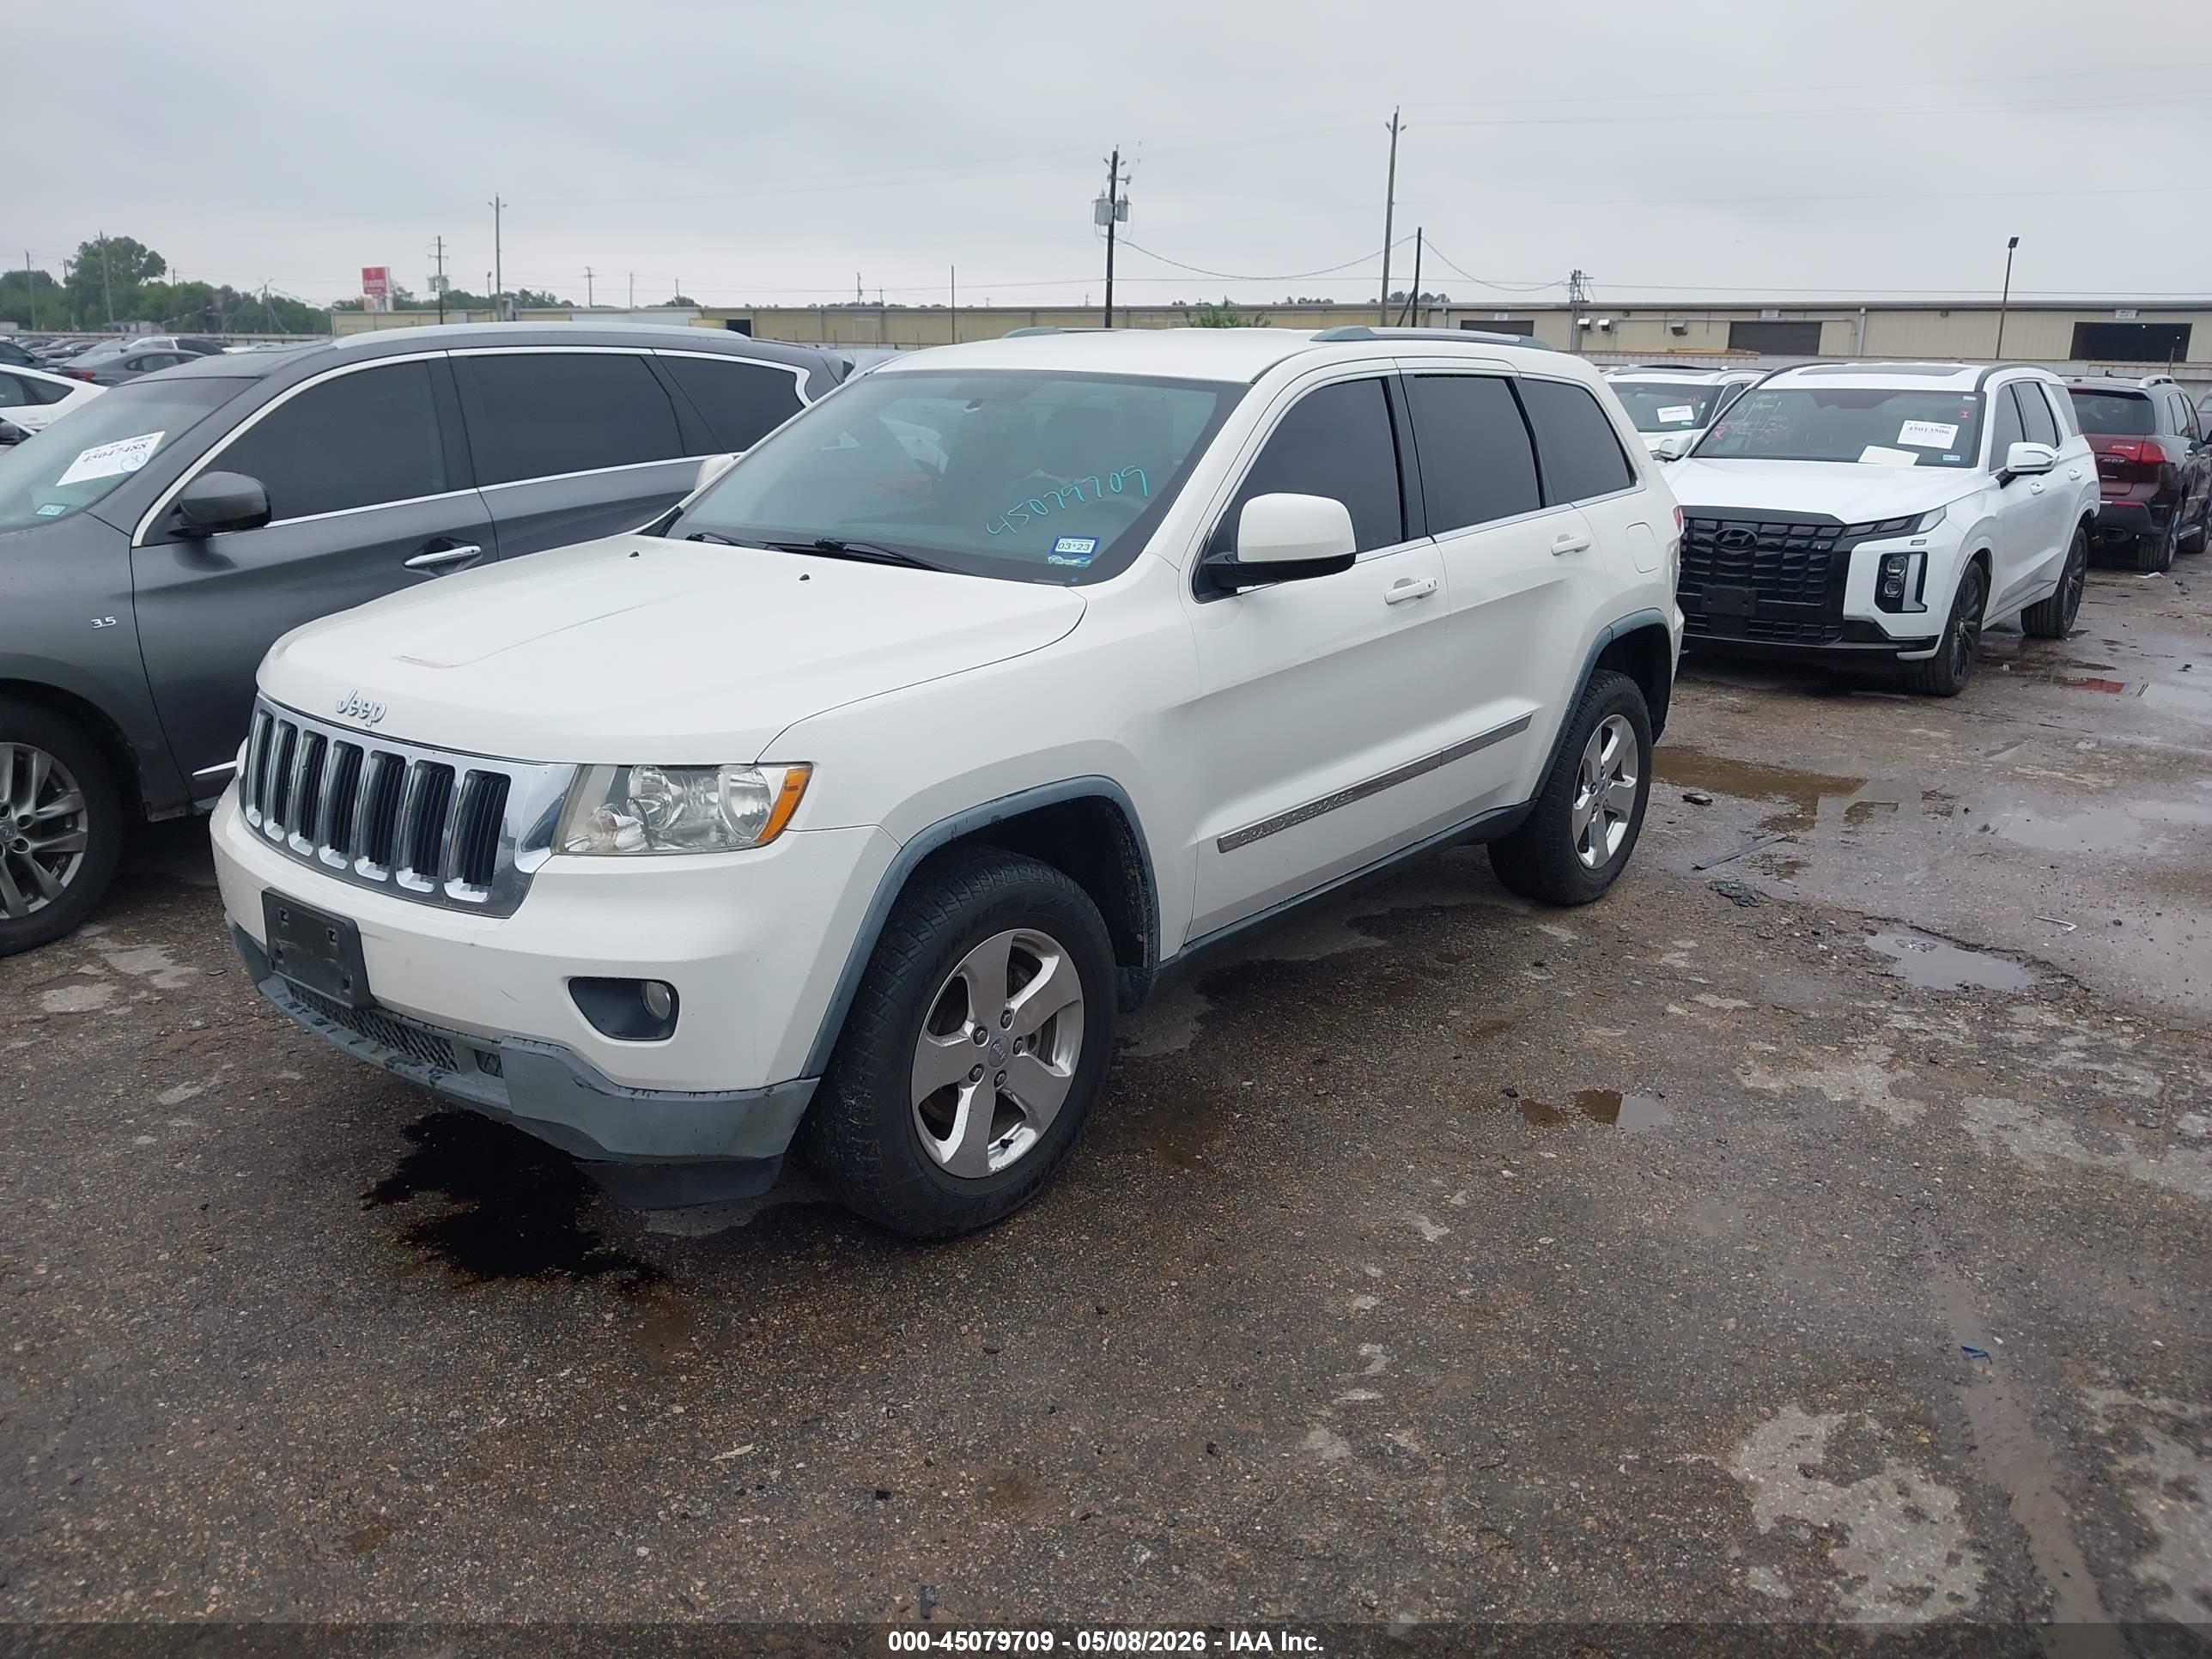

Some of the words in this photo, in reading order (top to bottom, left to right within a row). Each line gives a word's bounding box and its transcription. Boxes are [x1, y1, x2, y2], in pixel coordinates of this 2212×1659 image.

[987, 465, 1148, 535] 45079709
[1057, 542, 1072, 550] 03
[1076, 543, 1091, 551] 23
[336, 689, 387, 727] Jeep
